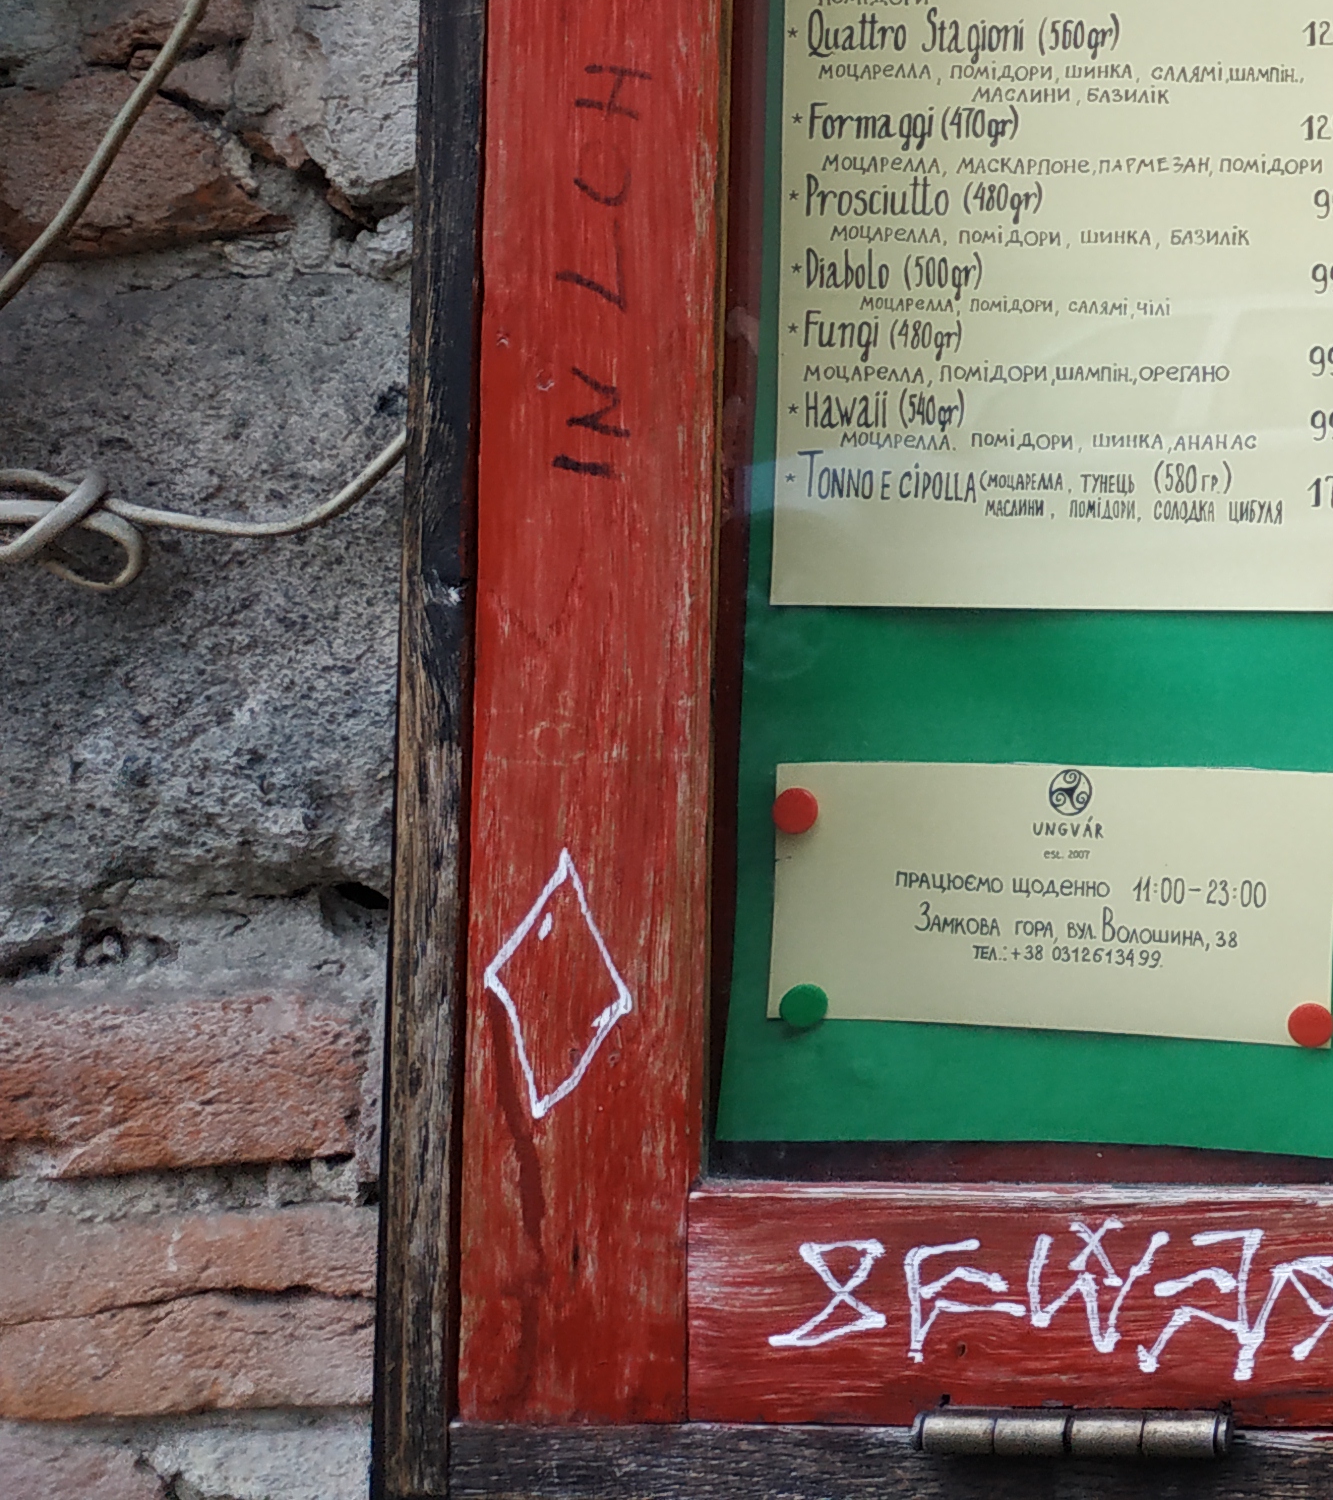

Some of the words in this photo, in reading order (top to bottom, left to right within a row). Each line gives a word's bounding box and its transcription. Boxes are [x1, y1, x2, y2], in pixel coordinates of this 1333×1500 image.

[808, 9, 906, 58] Quattro
[922, 7, 1024, 60] Stagioni
[809, 102, 934, 151] Formaggi
[806, 171, 949, 216] Prosciutto
[806, 248, 889, 290] Diabolo
[804, 310, 879, 363] Fungi
[1067, 850, 1090, 859] 2007
[1216, 931, 1238, 948] 38
